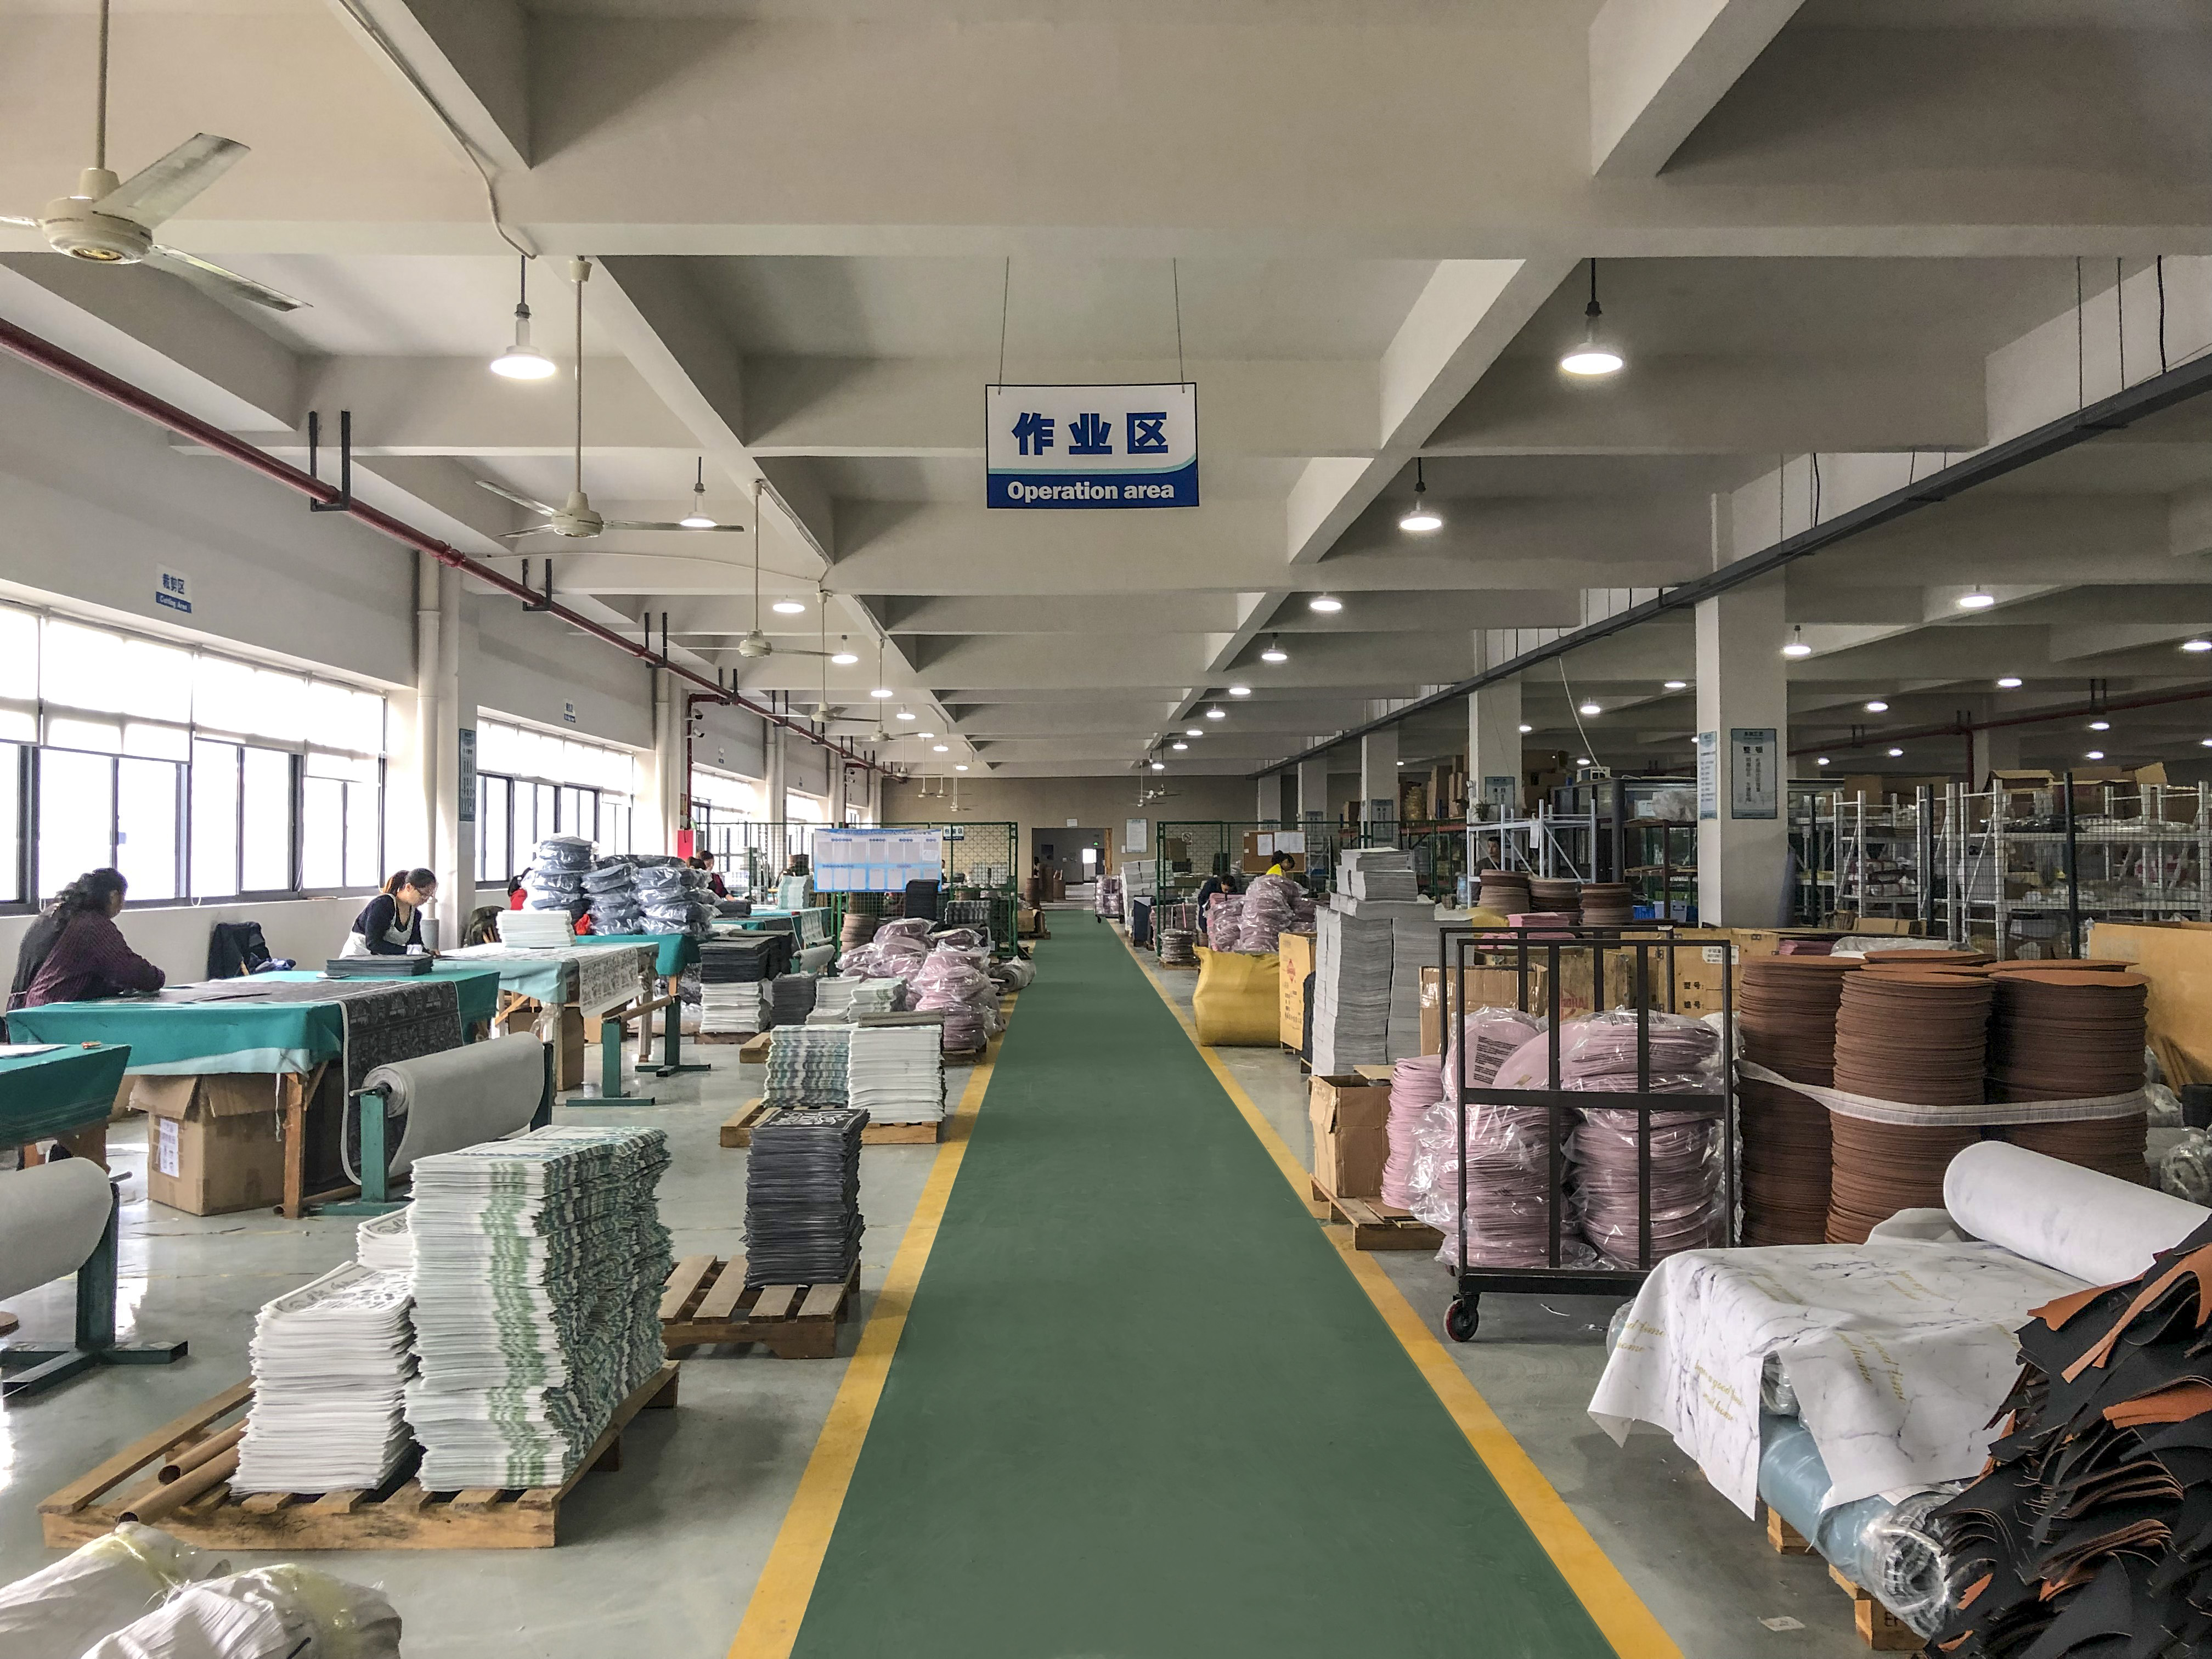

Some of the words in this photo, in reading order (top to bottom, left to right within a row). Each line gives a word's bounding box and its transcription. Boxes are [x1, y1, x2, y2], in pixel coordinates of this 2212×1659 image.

[1012, 412, 1169, 455] 作业区
[1007, 481, 1118, 503] Operation
[1124, 483, 1175, 499] area
